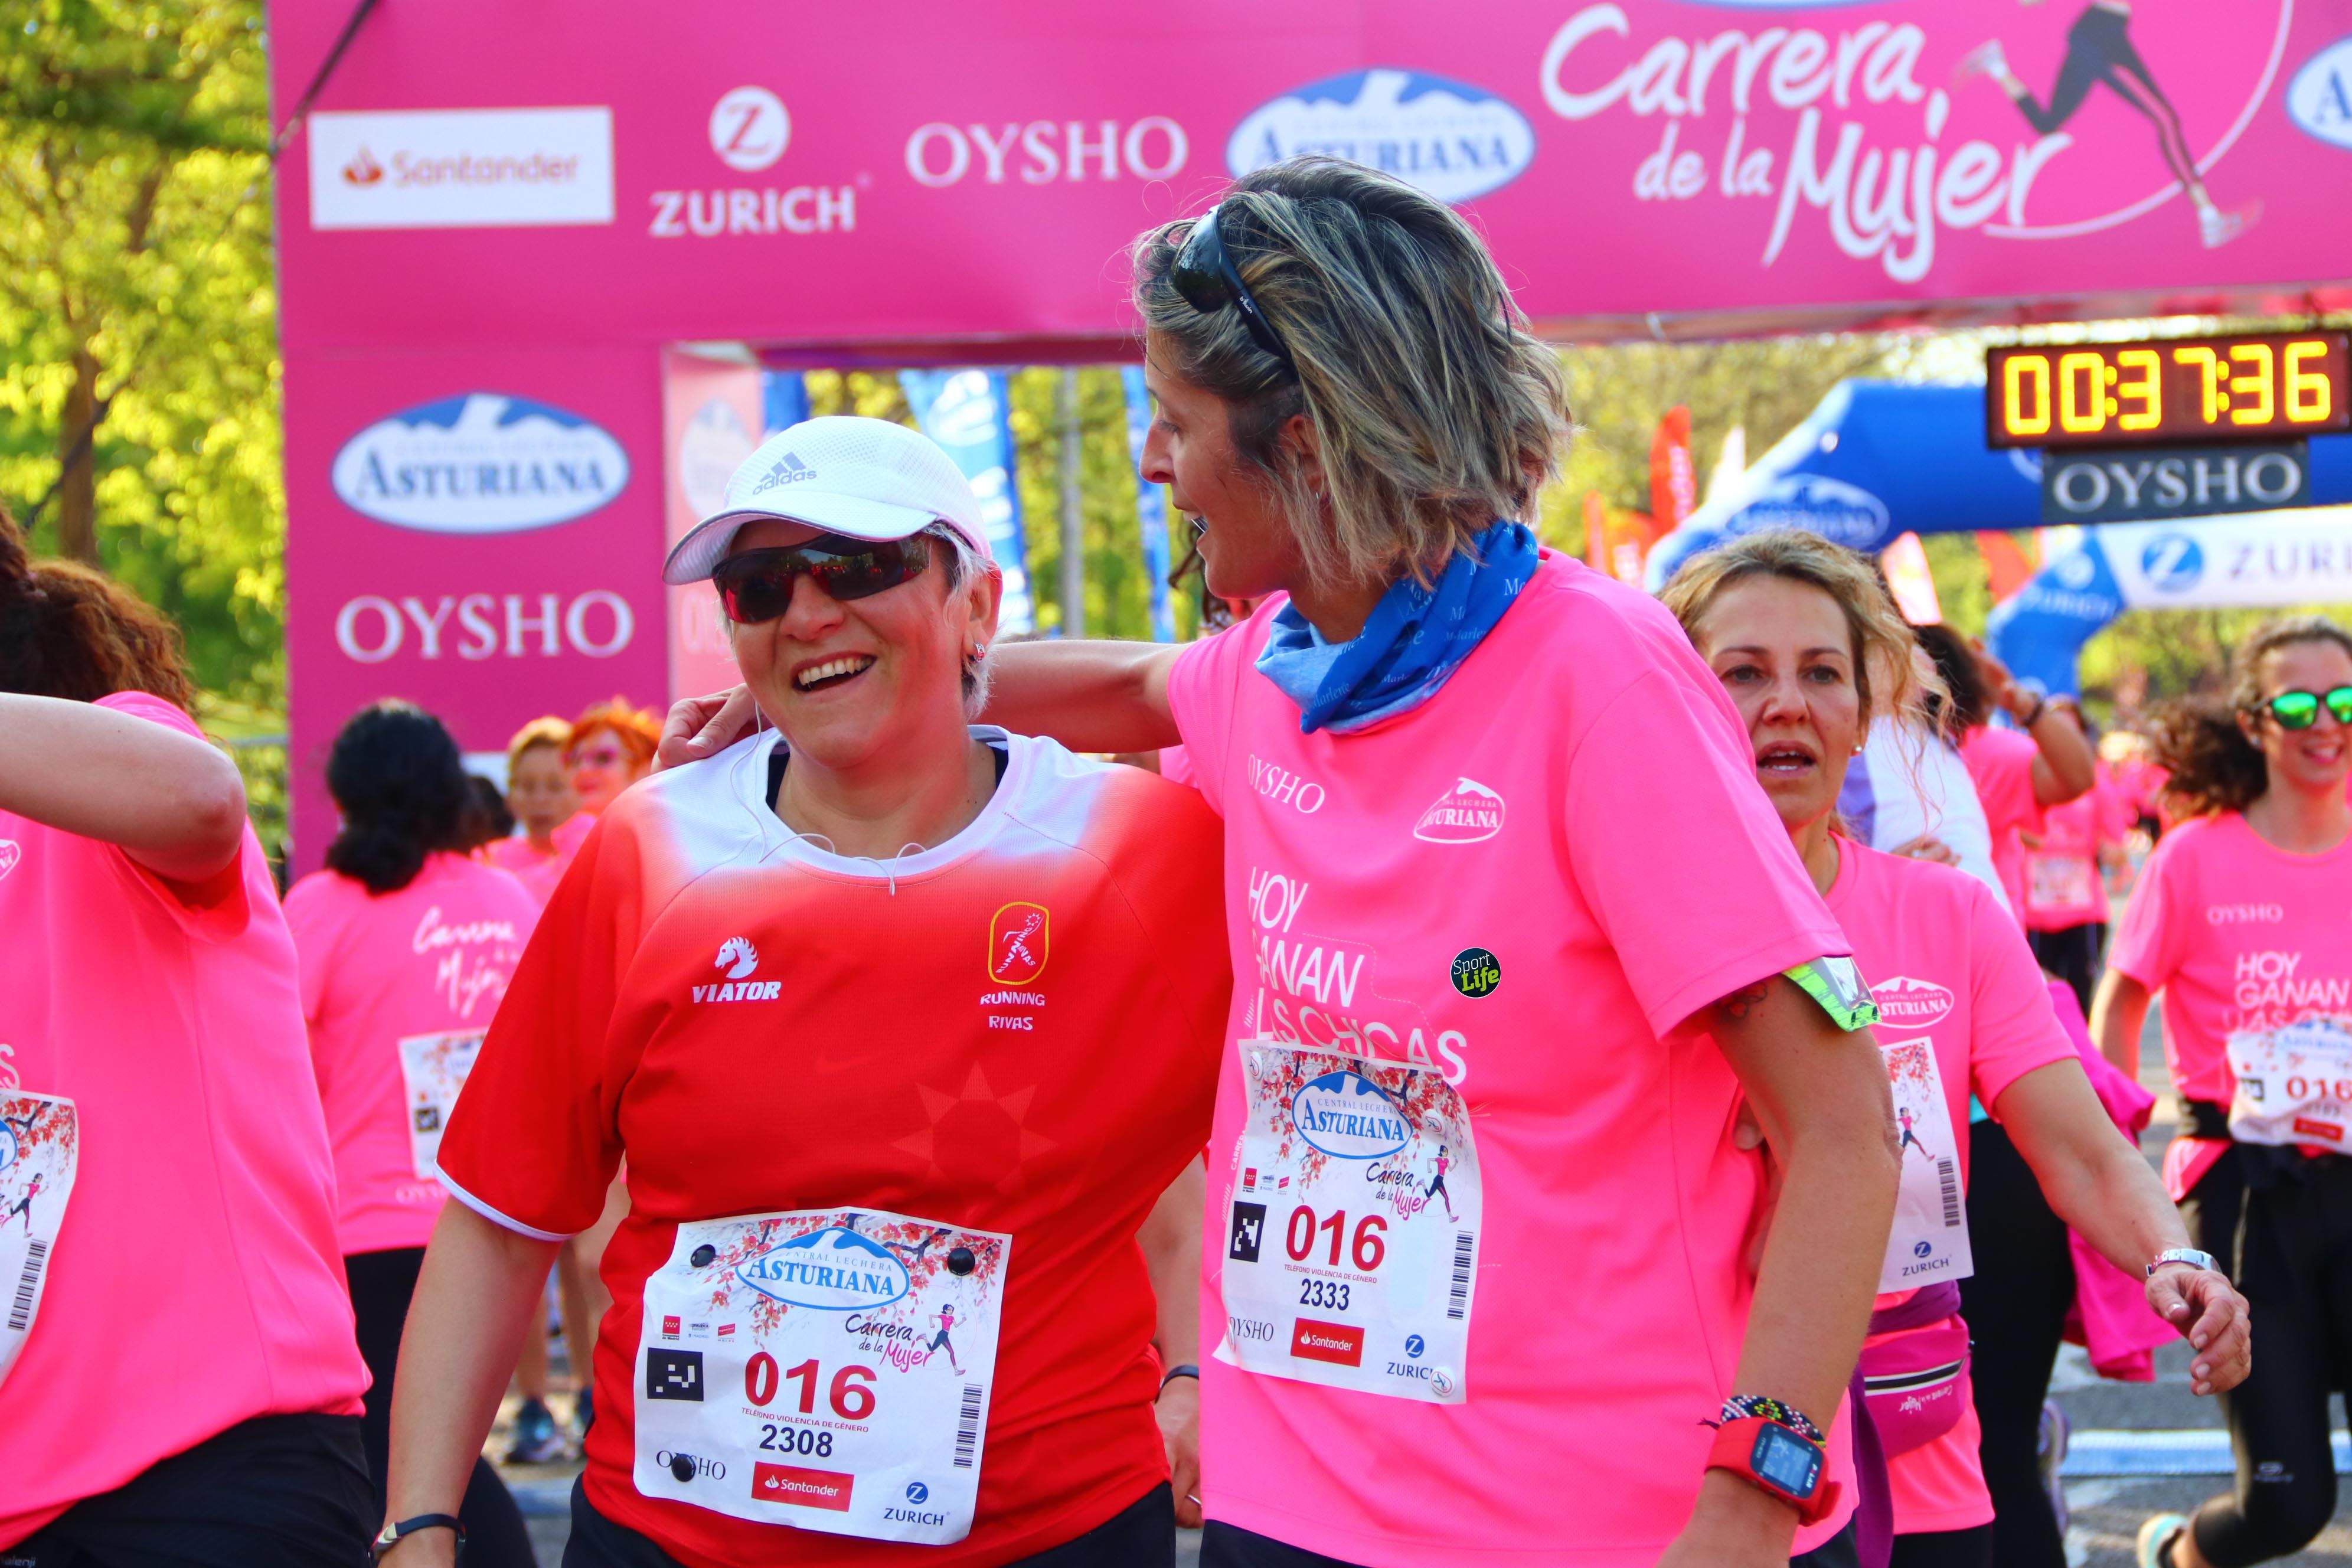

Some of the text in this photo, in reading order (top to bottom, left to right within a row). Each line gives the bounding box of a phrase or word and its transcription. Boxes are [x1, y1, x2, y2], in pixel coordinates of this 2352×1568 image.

[1540, 3, 1926, 119] Carrera
[392, 148, 579, 187] Santander
[904, 116, 1188, 188] OYSHO
[1633, 89, 2073, 283] de la Mujer
[649, 185, 855, 237] ZURICH
[2004, 341, 2331, 435] 00:37:36
[357, 446, 605, 499] ASTURIANA
[753, 471, 817, 495] adidas
[2053, 452, 2302, 512] OYSHO
[335, 589, 635, 664] OYSHO
[1248, 754, 1325, 814] OYSHO
[1249, 866, 1308, 932] HOY
[1453, 953, 1491, 975] Sport
[1461, 966, 1500, 992] Life
[2235, 951, 2301, 981] HOY
[692, 981, 782, 1004] VIATOR
[980, 991, 1045, 1006] RUNNING
[2235, 977, 2351, 1010] GANAN
[989, 1015, 1034, 1031] RIVAS
[1302, 1099, 1404, 1141] ASTURIANA
[1318, 1098, 1357, 1109] CENTRAL
[1366, 1162, 1414, 1187] Carrera
[1376, 1185, 1386, 1200] de
[1390, 1186, 1432, 1221] Mujer
[1285, 1204, 1389, 1272] 016
[746, 1256, 895, 1296] ASTURIANA
[836, 1255, 893, 1272] LECHERA
[1284, 1263, 1310, 1274] TELÉFONO
[1311, 1268, 1342, 1279] VIOLENCIA
[1352, 1273, 1377, 1284] GÉNERO
[1902, 1257, 1949, 1276] ZURICH
[1299, 1278, 1350, 1311] 2333
[845, 1314, 913, 1341] Carrera
[1311, 1334, 1353, 1351] Santander
[858, 1337, 936, 1373] de la Mujer
[744, 1351, 878, 1420] 016
[776, 1415, 820, 1427] VIOLENCIA
[834, 1422, 869, 1433] GÉNERO
[759, 1424, 833, 1458] 2308
[780, 1478, 839, 1497] Santander
[883, 1507, 945, 1526] ZURICH
